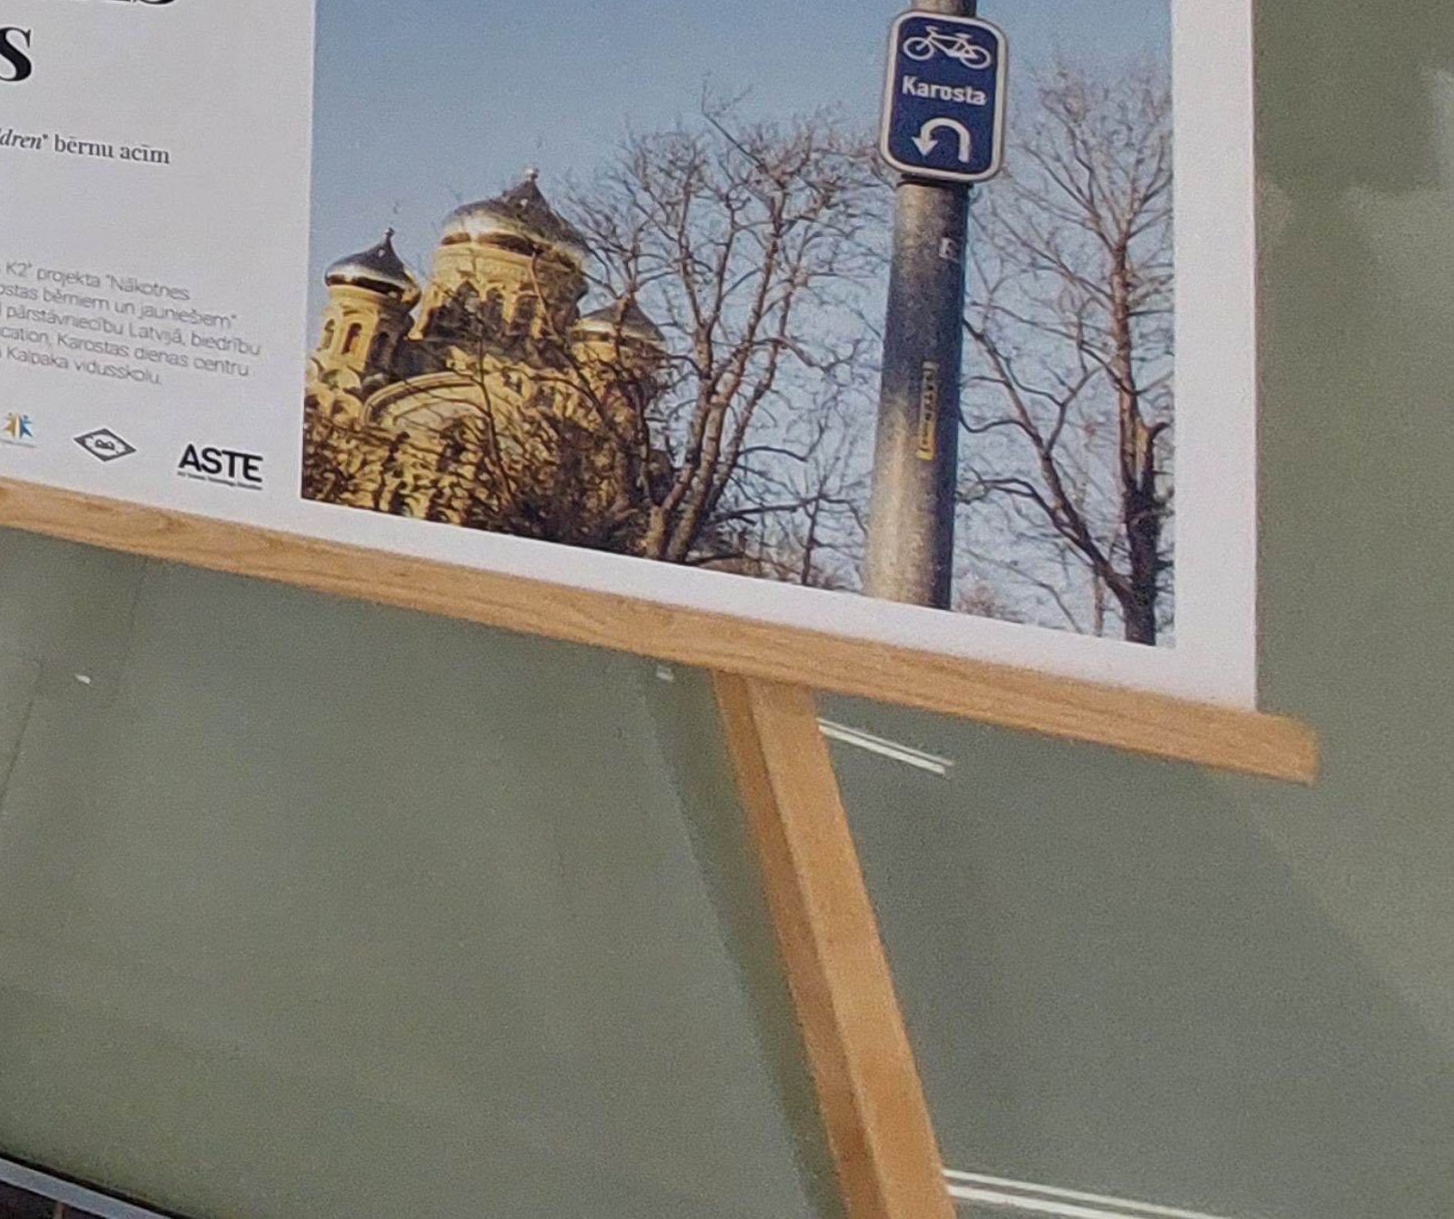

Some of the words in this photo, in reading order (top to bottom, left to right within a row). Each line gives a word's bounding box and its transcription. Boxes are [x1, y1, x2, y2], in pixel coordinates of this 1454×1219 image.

[902, 75, 987, 106] Karosta
[54, 133, 114, 159] bērnu
[119, 143, 170, 165] acīm
[115, 300, 135, 315] un
[6, 346, 69, 369] Kalpaka
[57, 333, 129, 358] Karostas
[134, 347, 189, 367] dienas
[194, 357, 249, 377] centru
[178, 443, 263, 483] ASTE
